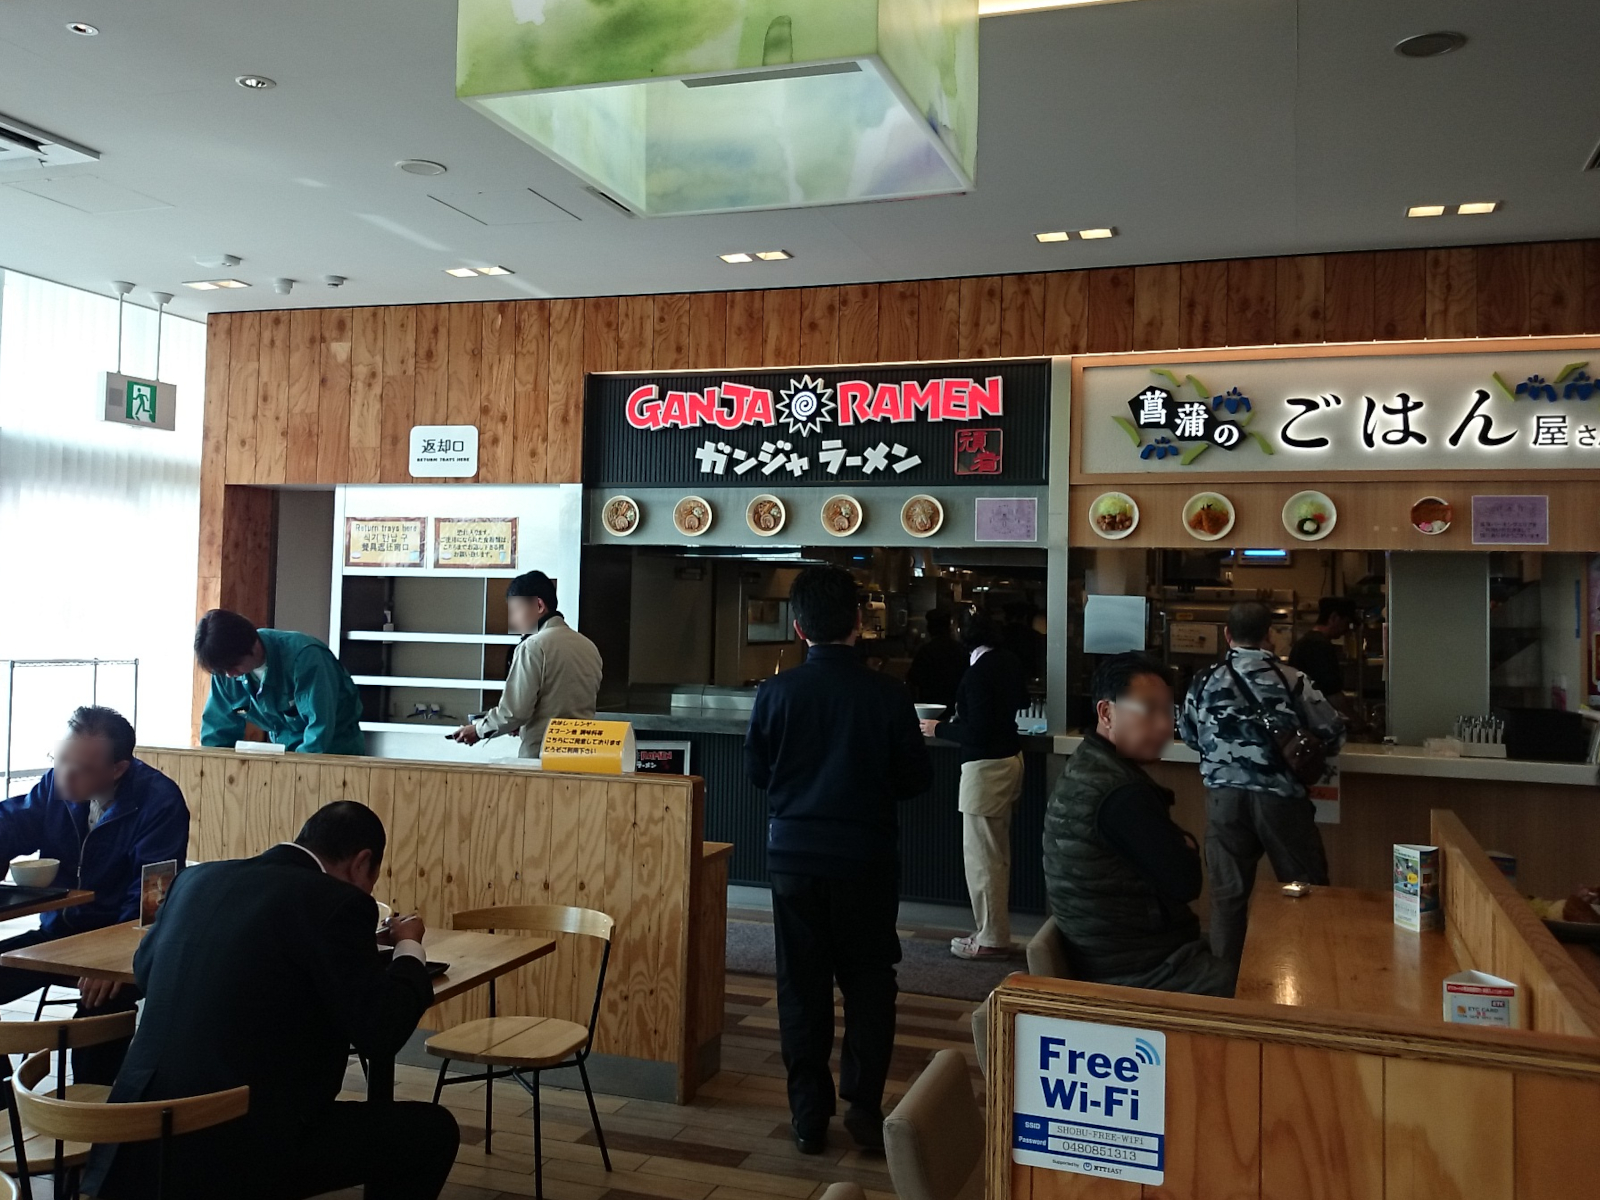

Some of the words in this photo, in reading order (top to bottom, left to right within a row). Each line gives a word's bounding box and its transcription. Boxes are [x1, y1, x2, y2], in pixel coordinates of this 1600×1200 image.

[626, 381, 776, 431] GANJA
[837, 376, 1003, 426] RAMEN
[1139, 390, 1240, 447] 菖蒲の
[1281, 389, 1600, 449] ごはん屋さ
[421, 438, 464, 454] 返却口
[695, 440, 810, 477] ガンジャ
[819, 439, 922, 475] ラーメン
[355, 524, 379, 532] Return
[381, 525, 400, 533] trays
[402, 523, 417, 532] here
[640, 751, 673, 760] RAMEN
[1039, 1035, 1140, 1083] Free
[1039, 1075, 1139, 1121] Wi-Fi
[1018, 1135, 1047, 1147] Password
[1062, 1140, 1138, 1161] 0480851313
[1024, 1121, 1041, 1130] SSID
[1056, 1125, 1145, 1146] SHOBU-FREE-WiFi
